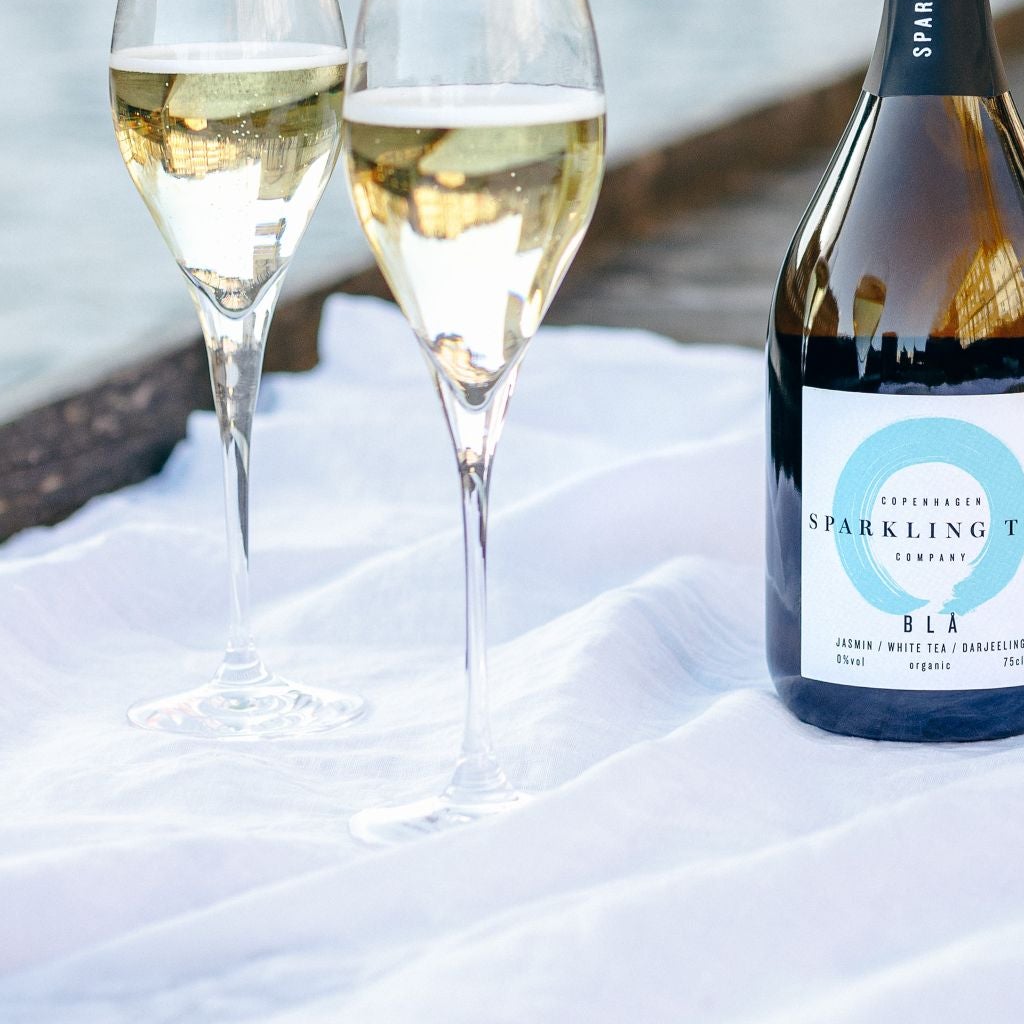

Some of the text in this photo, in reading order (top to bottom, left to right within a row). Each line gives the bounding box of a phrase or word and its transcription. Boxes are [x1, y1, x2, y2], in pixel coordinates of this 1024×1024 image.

[881, 496, 982, 506] COPENHAGEN
[808, 512, 987, 538] SPARKLING
[895, 552, 966, 562] COMPANY
[903, 612, 958, 633] BLÅ
[836, 637, 873, 650] JASMIN
[887, 641, 922, 653] WHITE
[926, 643, 947, 654] TEA
[909, 660, 951, 672] organic
[1003, 655, 1024, 667] 75cl
